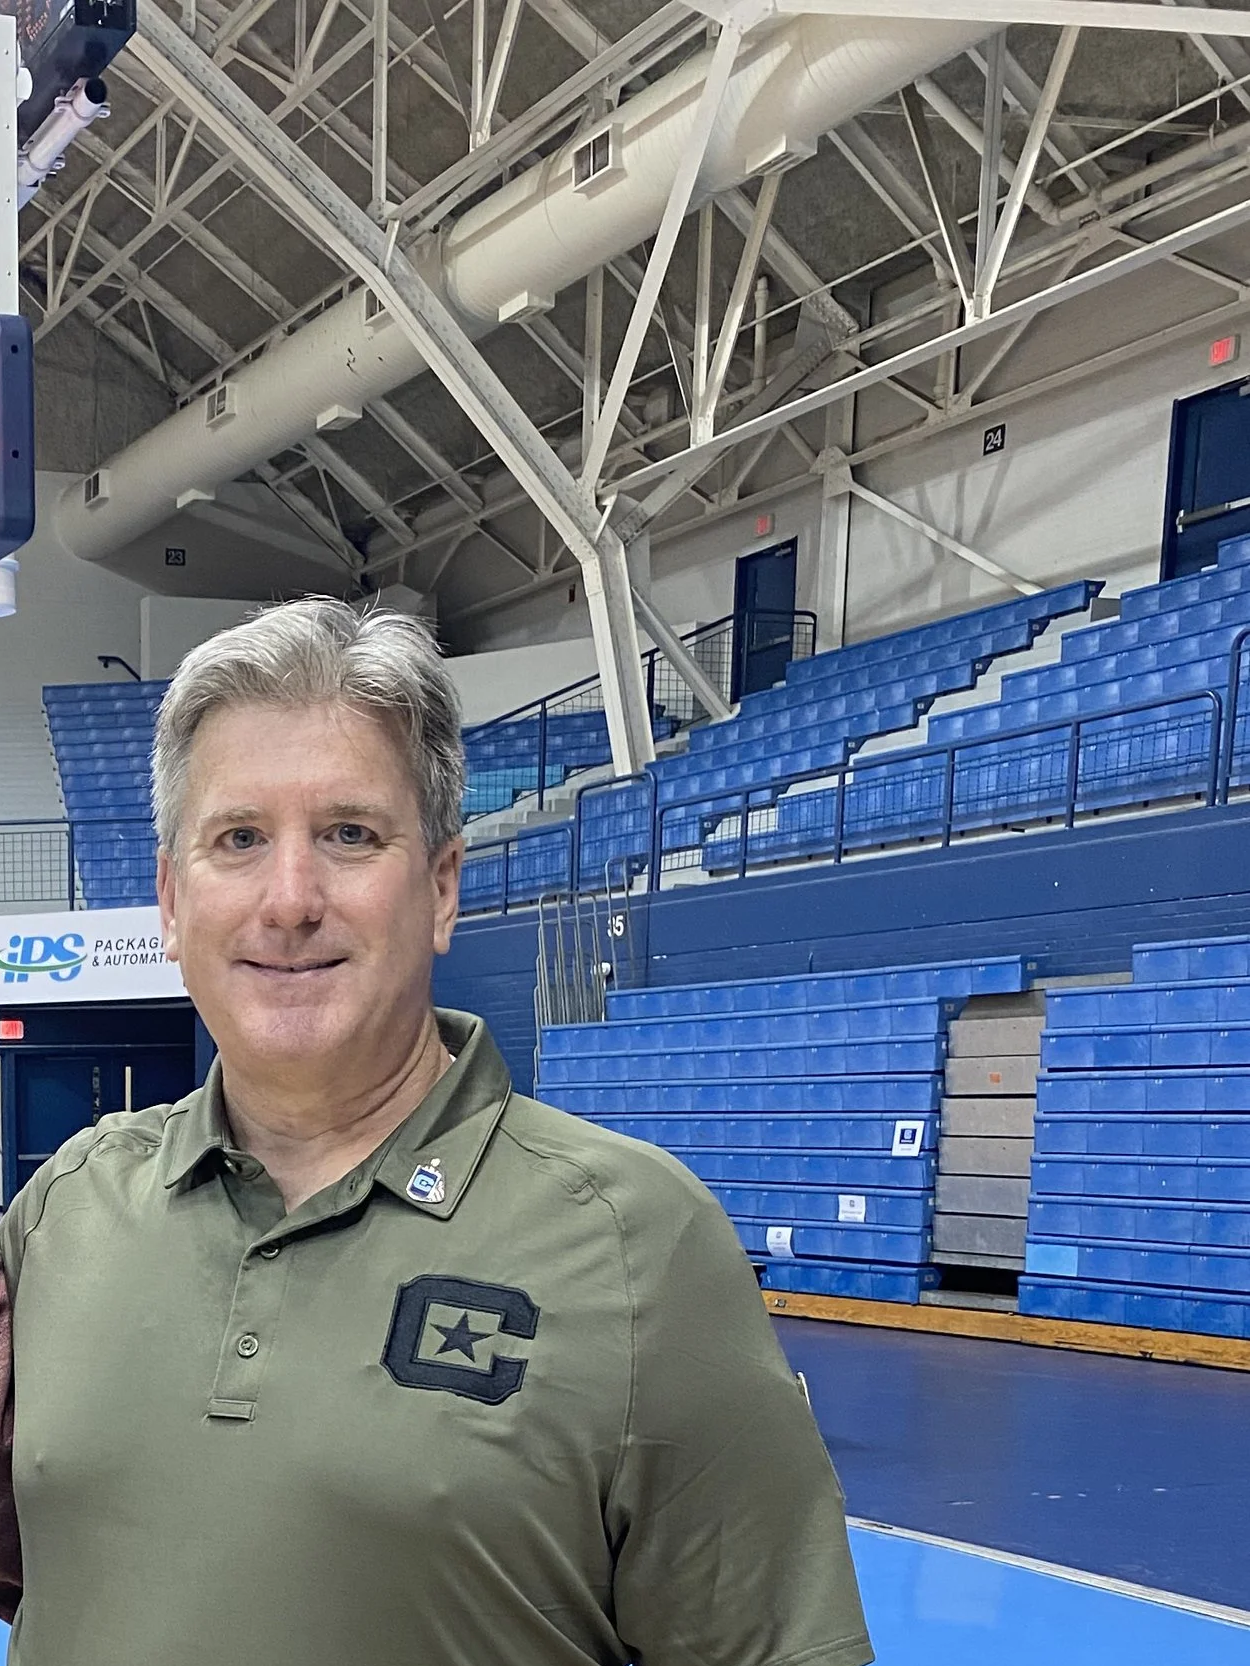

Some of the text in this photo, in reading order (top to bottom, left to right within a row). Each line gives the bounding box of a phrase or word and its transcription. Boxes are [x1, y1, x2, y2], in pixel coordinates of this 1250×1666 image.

[986, 429, 1002, 451] 24
[168, 551, 183, 564] 23
[92, 956, 99, 967] &
[380, 1274, 541, 1406] C
